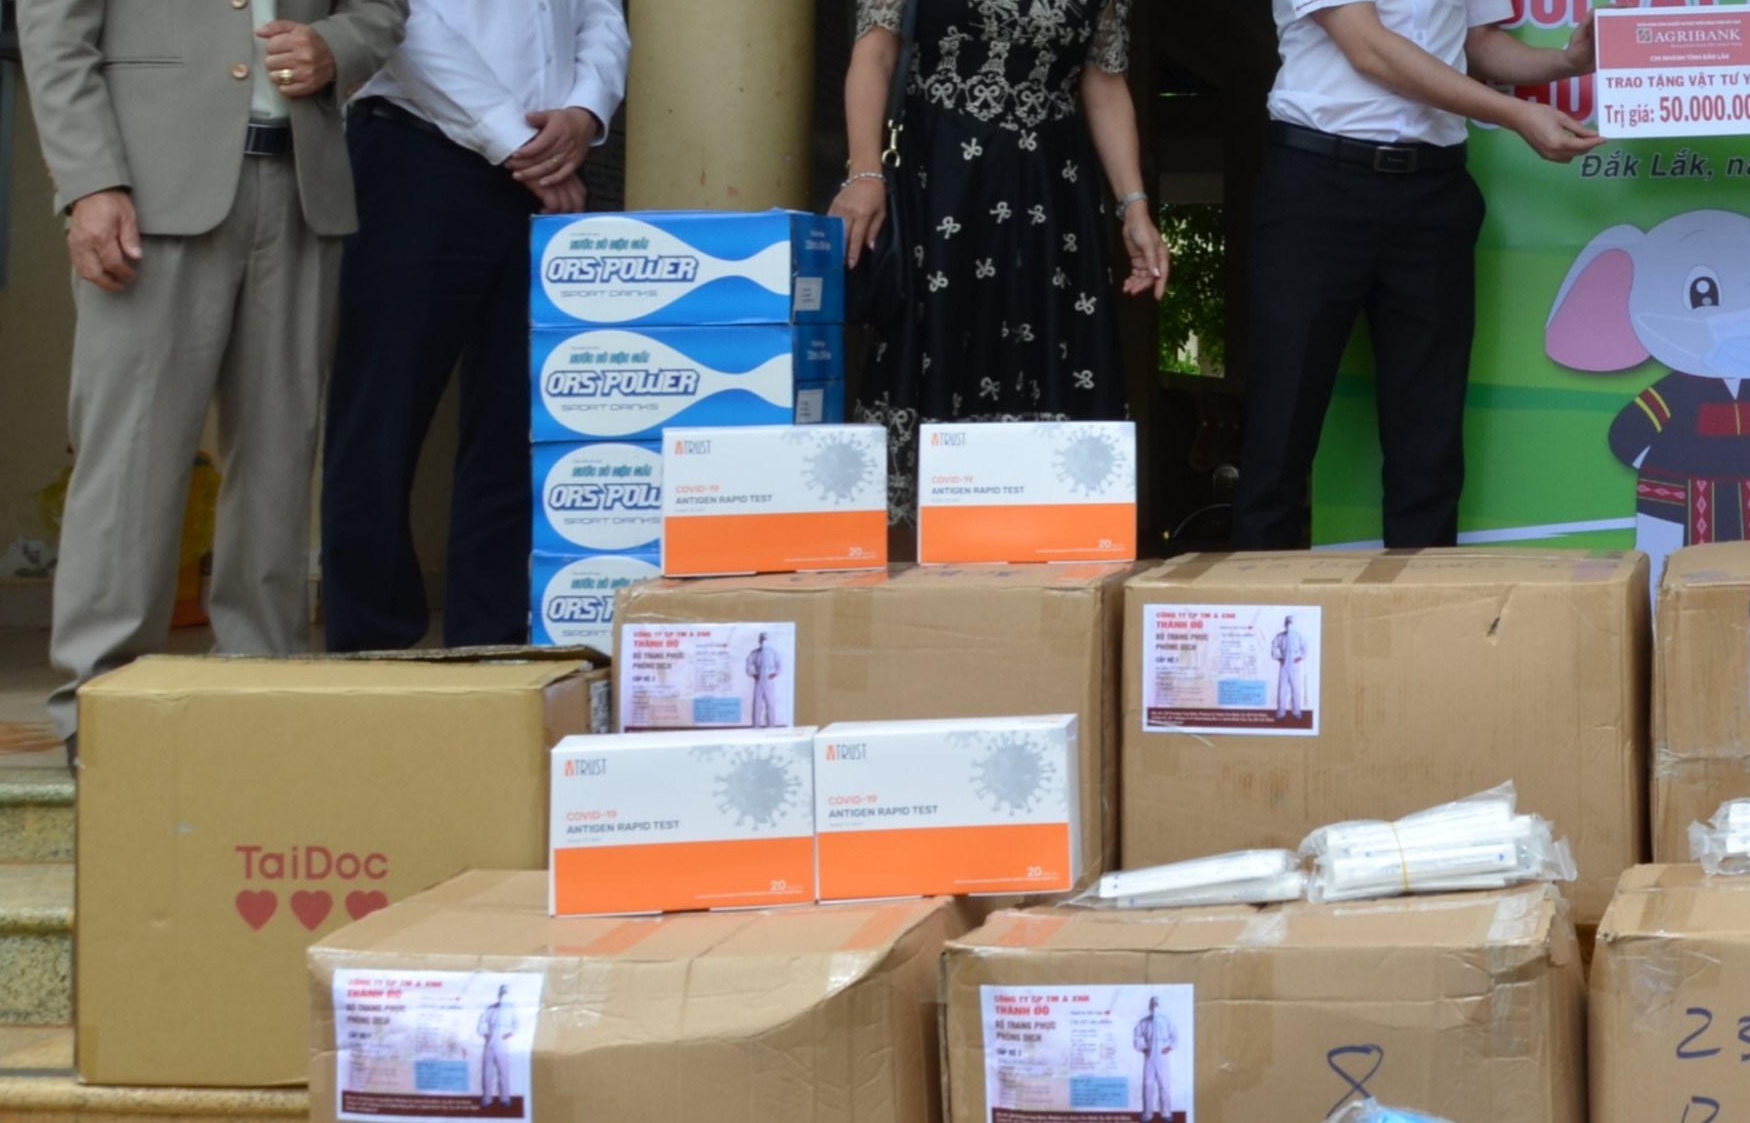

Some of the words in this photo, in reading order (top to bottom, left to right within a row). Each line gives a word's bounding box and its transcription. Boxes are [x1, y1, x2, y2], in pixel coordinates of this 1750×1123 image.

[1654, 28, 1742, 44] AGRIBANK
[1650, 54, 1662, 63] CHI
[1604, 75, 1644, 89] TRAO
[1648, 74, 1685, 91] TẶNG
[1688, 71, 1716, 89] VẬT
[1720, 71, 1740, 86] TƯ
[1604, 104, 1625, 129] Trị
[1628, 103, 1655, 127] giá:
[1580, 143, 1644, 182] Đắk
[1649, 138, 1712, 182] Lắk,
[545, 255, 603, 285] ORS
[599, 254, 699, 284] POWER
[561, 289, 609, 298] SPORT
[545, 368, 602, 398] ORS
[599, 366, 701, 396] POWER
[235, 844, 389, 881] TaiDoc
